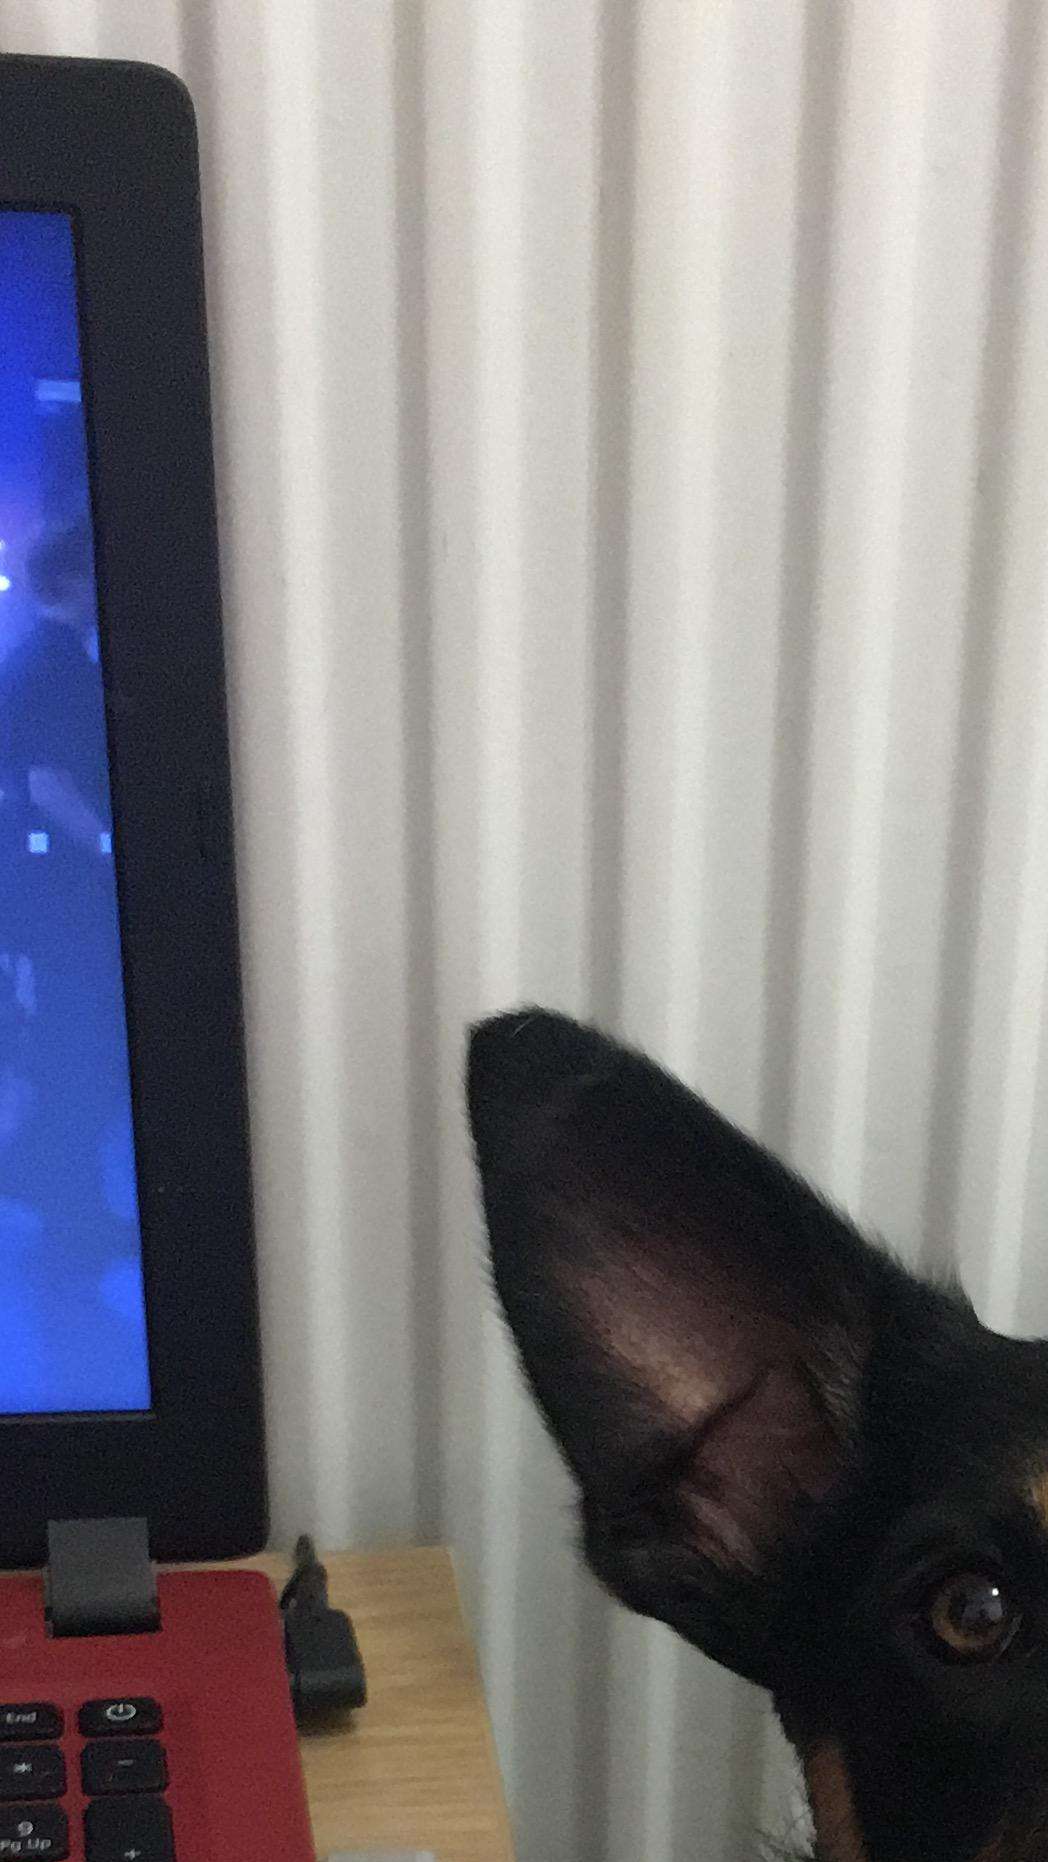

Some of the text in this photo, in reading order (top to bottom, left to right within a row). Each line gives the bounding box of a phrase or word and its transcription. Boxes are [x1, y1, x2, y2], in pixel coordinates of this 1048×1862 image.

[6, 1711, 37, 1724] End
[18, 1821, 34, 1837] 9
[27, 1838, 52, 1851] Up
